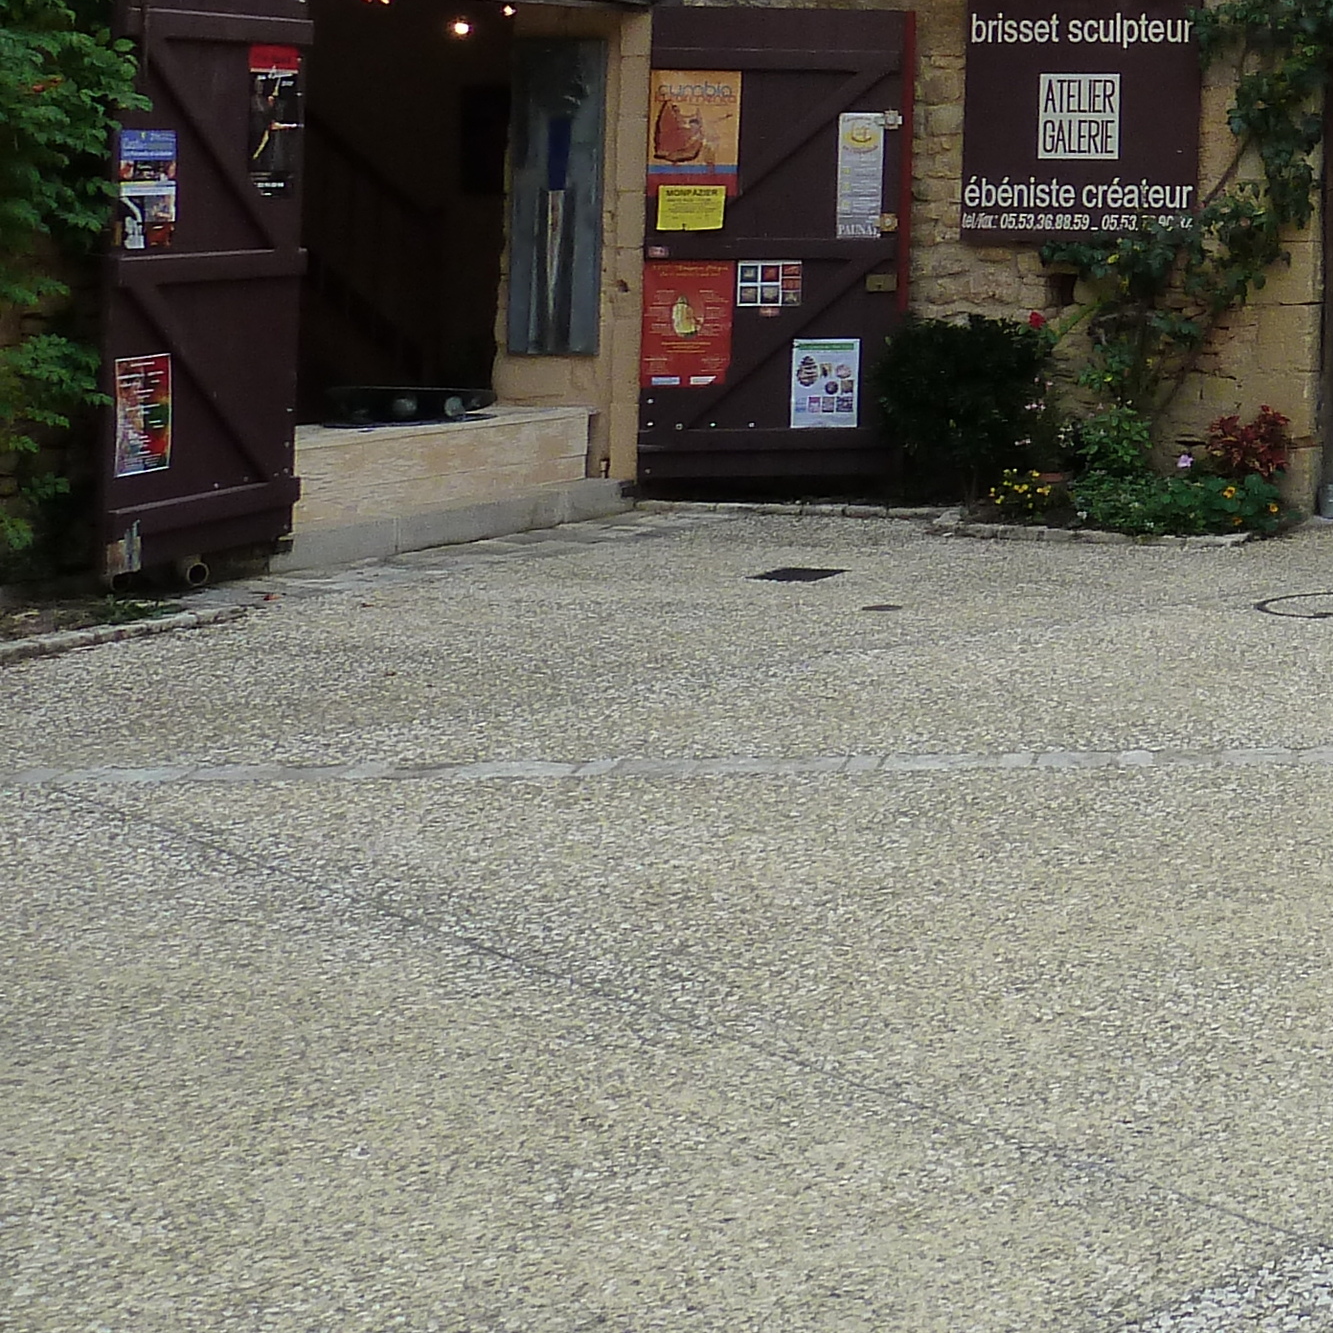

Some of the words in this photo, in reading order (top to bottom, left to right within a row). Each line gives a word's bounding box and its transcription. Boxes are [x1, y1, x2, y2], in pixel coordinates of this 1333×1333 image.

[971, 13, 1060, 44] brisset
[1067, 13, 1194, 49] sculpteur
[1043, 79, 1115, 114] ATELIER
[1042, 119, 1115, 155] GALERIE
[963, 176, 1076, 208] ébéniste
[1081, 177, 1194, 209] créateur
[999, 213, 1090, 231] 05.53.36.88.59
